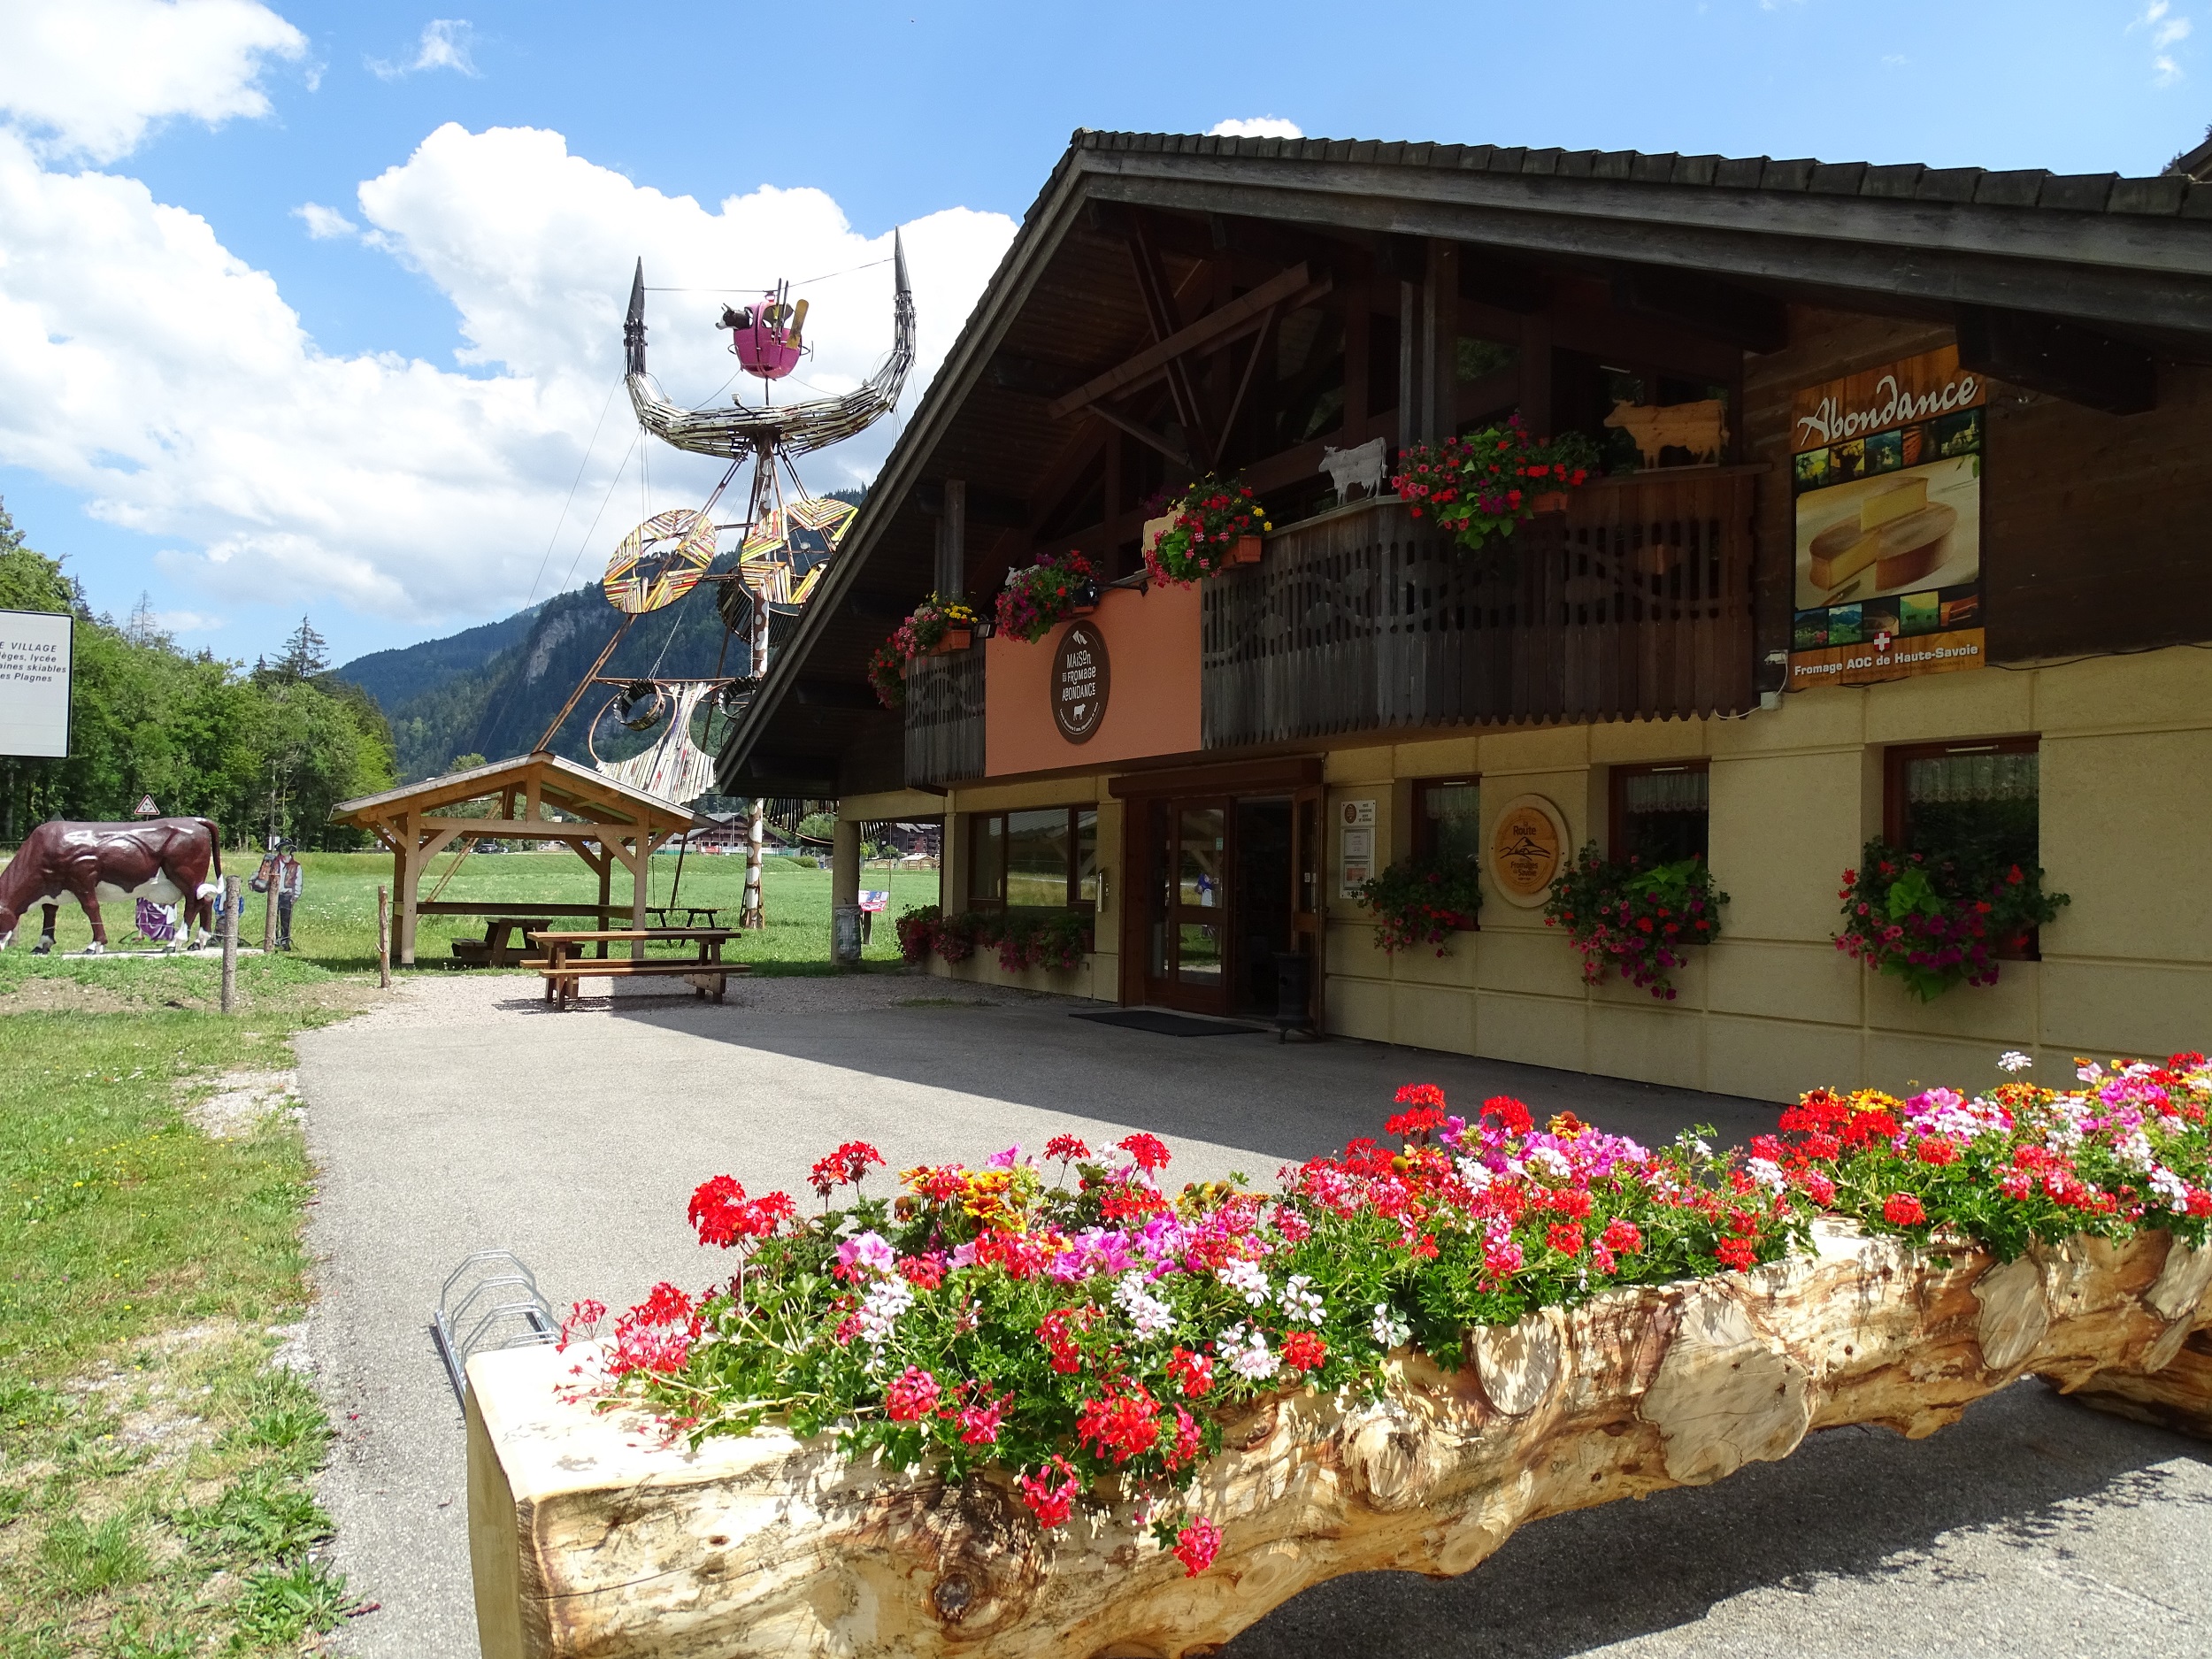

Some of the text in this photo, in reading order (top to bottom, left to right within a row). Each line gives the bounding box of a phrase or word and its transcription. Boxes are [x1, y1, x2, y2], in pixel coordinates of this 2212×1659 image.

[1797, 375, 1978, 447] Abondance
[12, 642, 57, 653] VILLAGE
[30, 653, 57, 663] lycée
[1794, 660, 1843, 676] Fromage
[1847, 656, 1872, 670] AOC
[1876, 655, 1890, 666] de
[1894, 643, 1978, 665] Haute-Savoie
[27, 664, 66, 673] skiables
[14, 672, 52, 683] Plagnes
[1062, 682, 1096, 702] ABONDANCE
[1513, 826, 1537, 835] Route
[1510, 861, 1538, 870] Fromages
